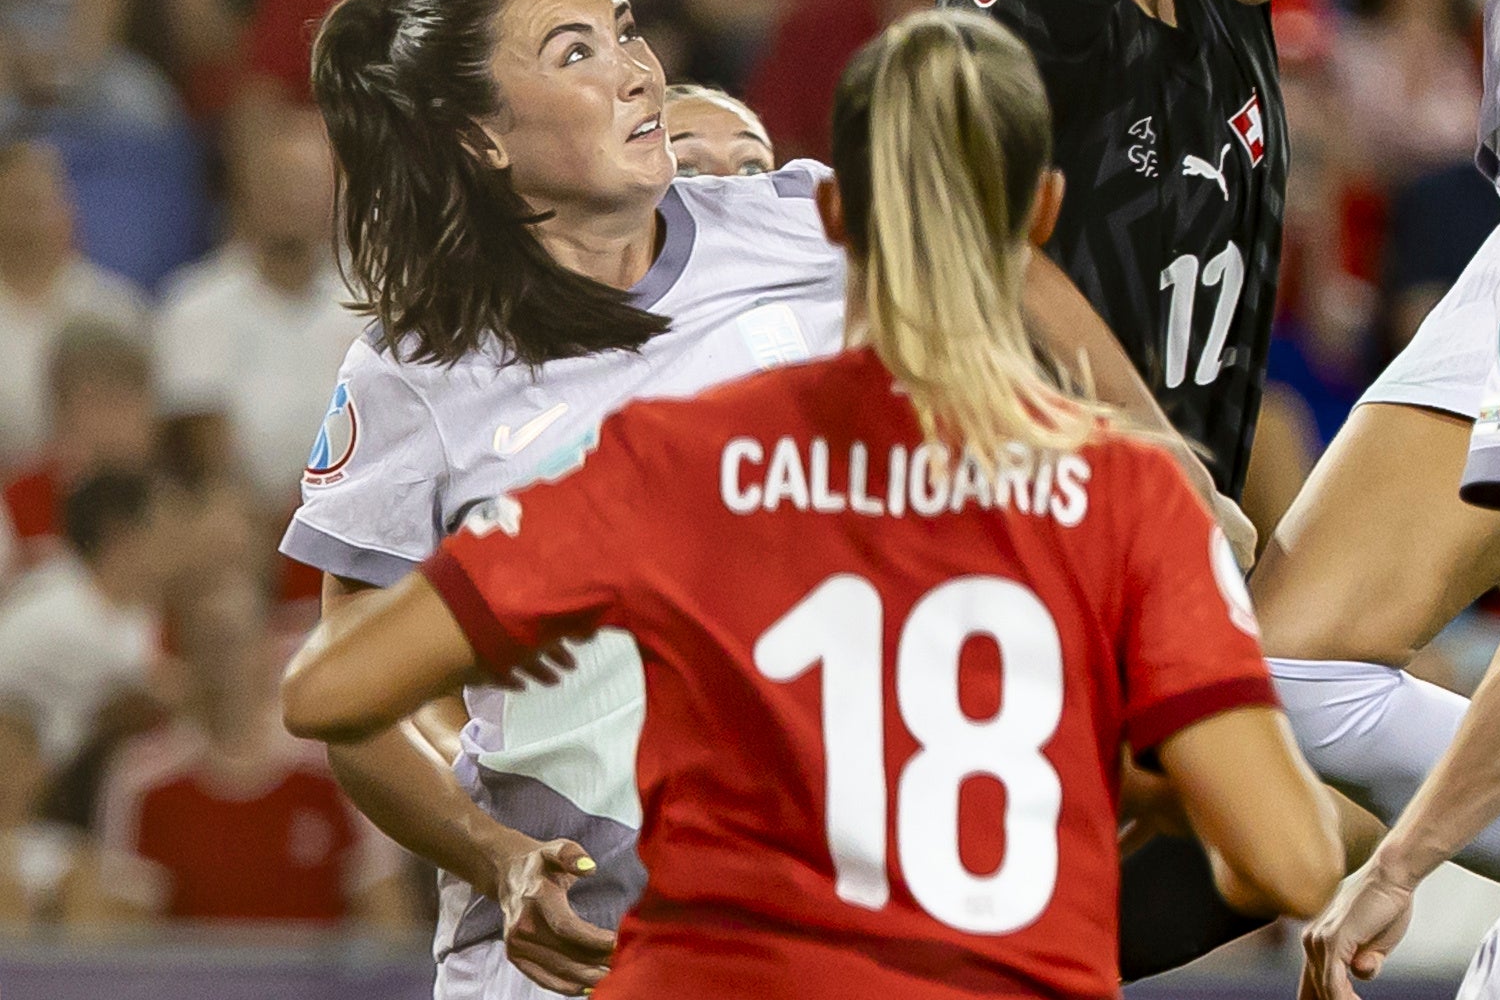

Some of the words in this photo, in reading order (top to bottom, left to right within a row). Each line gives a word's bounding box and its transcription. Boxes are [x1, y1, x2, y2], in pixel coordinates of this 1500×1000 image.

[1160, 240, 1244, 388] 12
[720, 436, 1092, 528] CALLIGARIS
[753, 573, 1064, 935] 18
